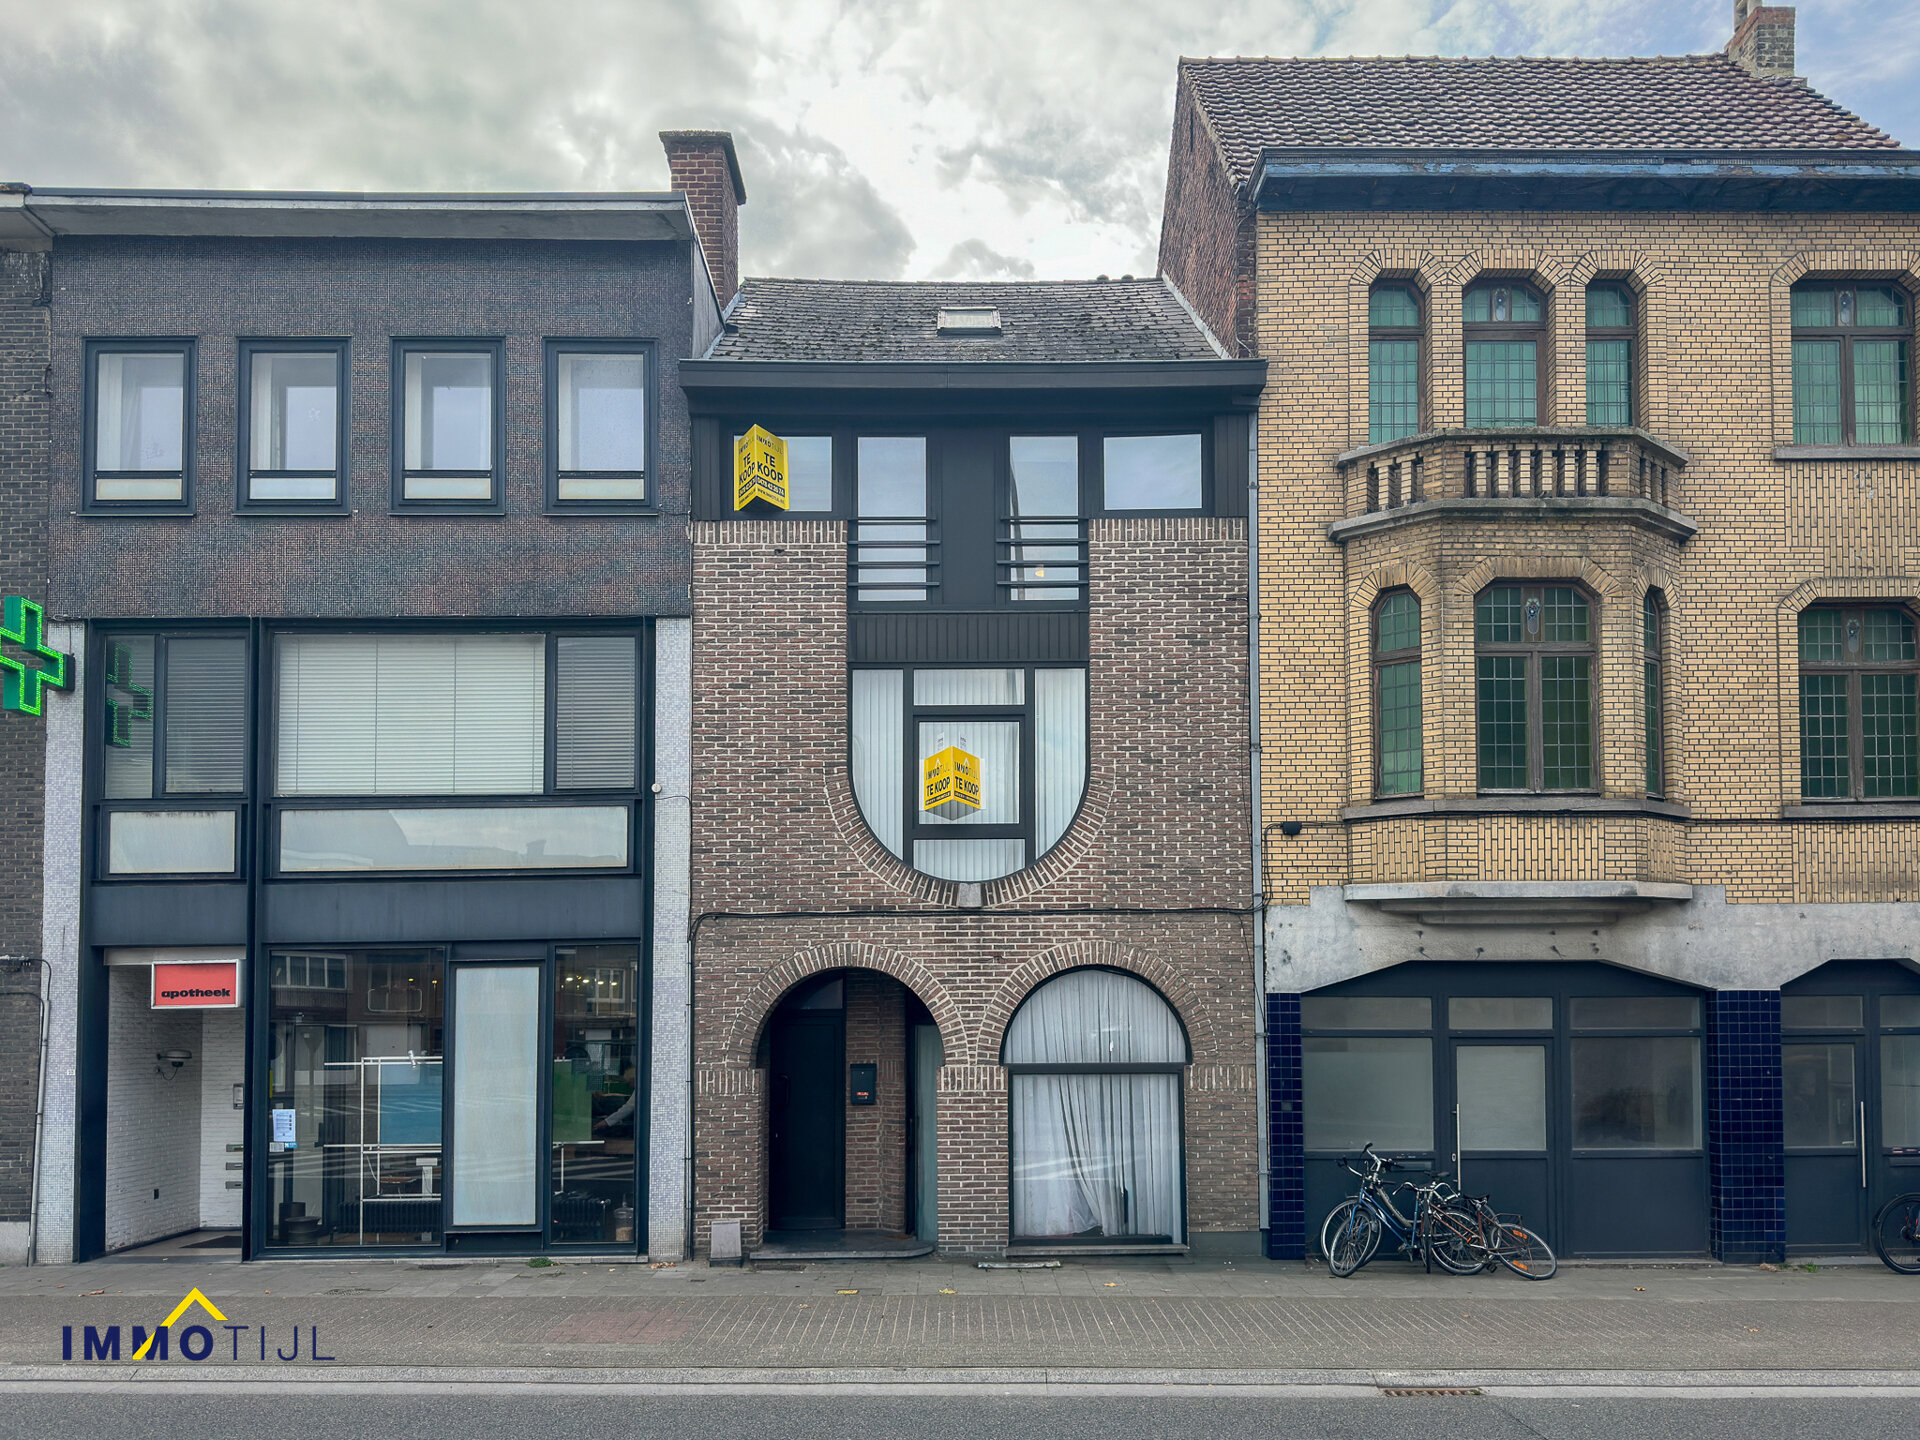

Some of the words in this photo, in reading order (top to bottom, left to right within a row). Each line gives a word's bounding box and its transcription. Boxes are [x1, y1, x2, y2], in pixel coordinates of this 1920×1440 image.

[743, 452, 751, 468] TE
[763, 452, 776, 468] TE
[739, 462, 756, 484] KOOP
[757, 462, 783, 483] KOOP
[926, 784, 933, 797] TE
[934, 776, 950, 793] KOOP
[955, 776, 963, 790] TE
[964, 780, 979, 797] KOOP
[161, 988, 231, 999] apotheek
